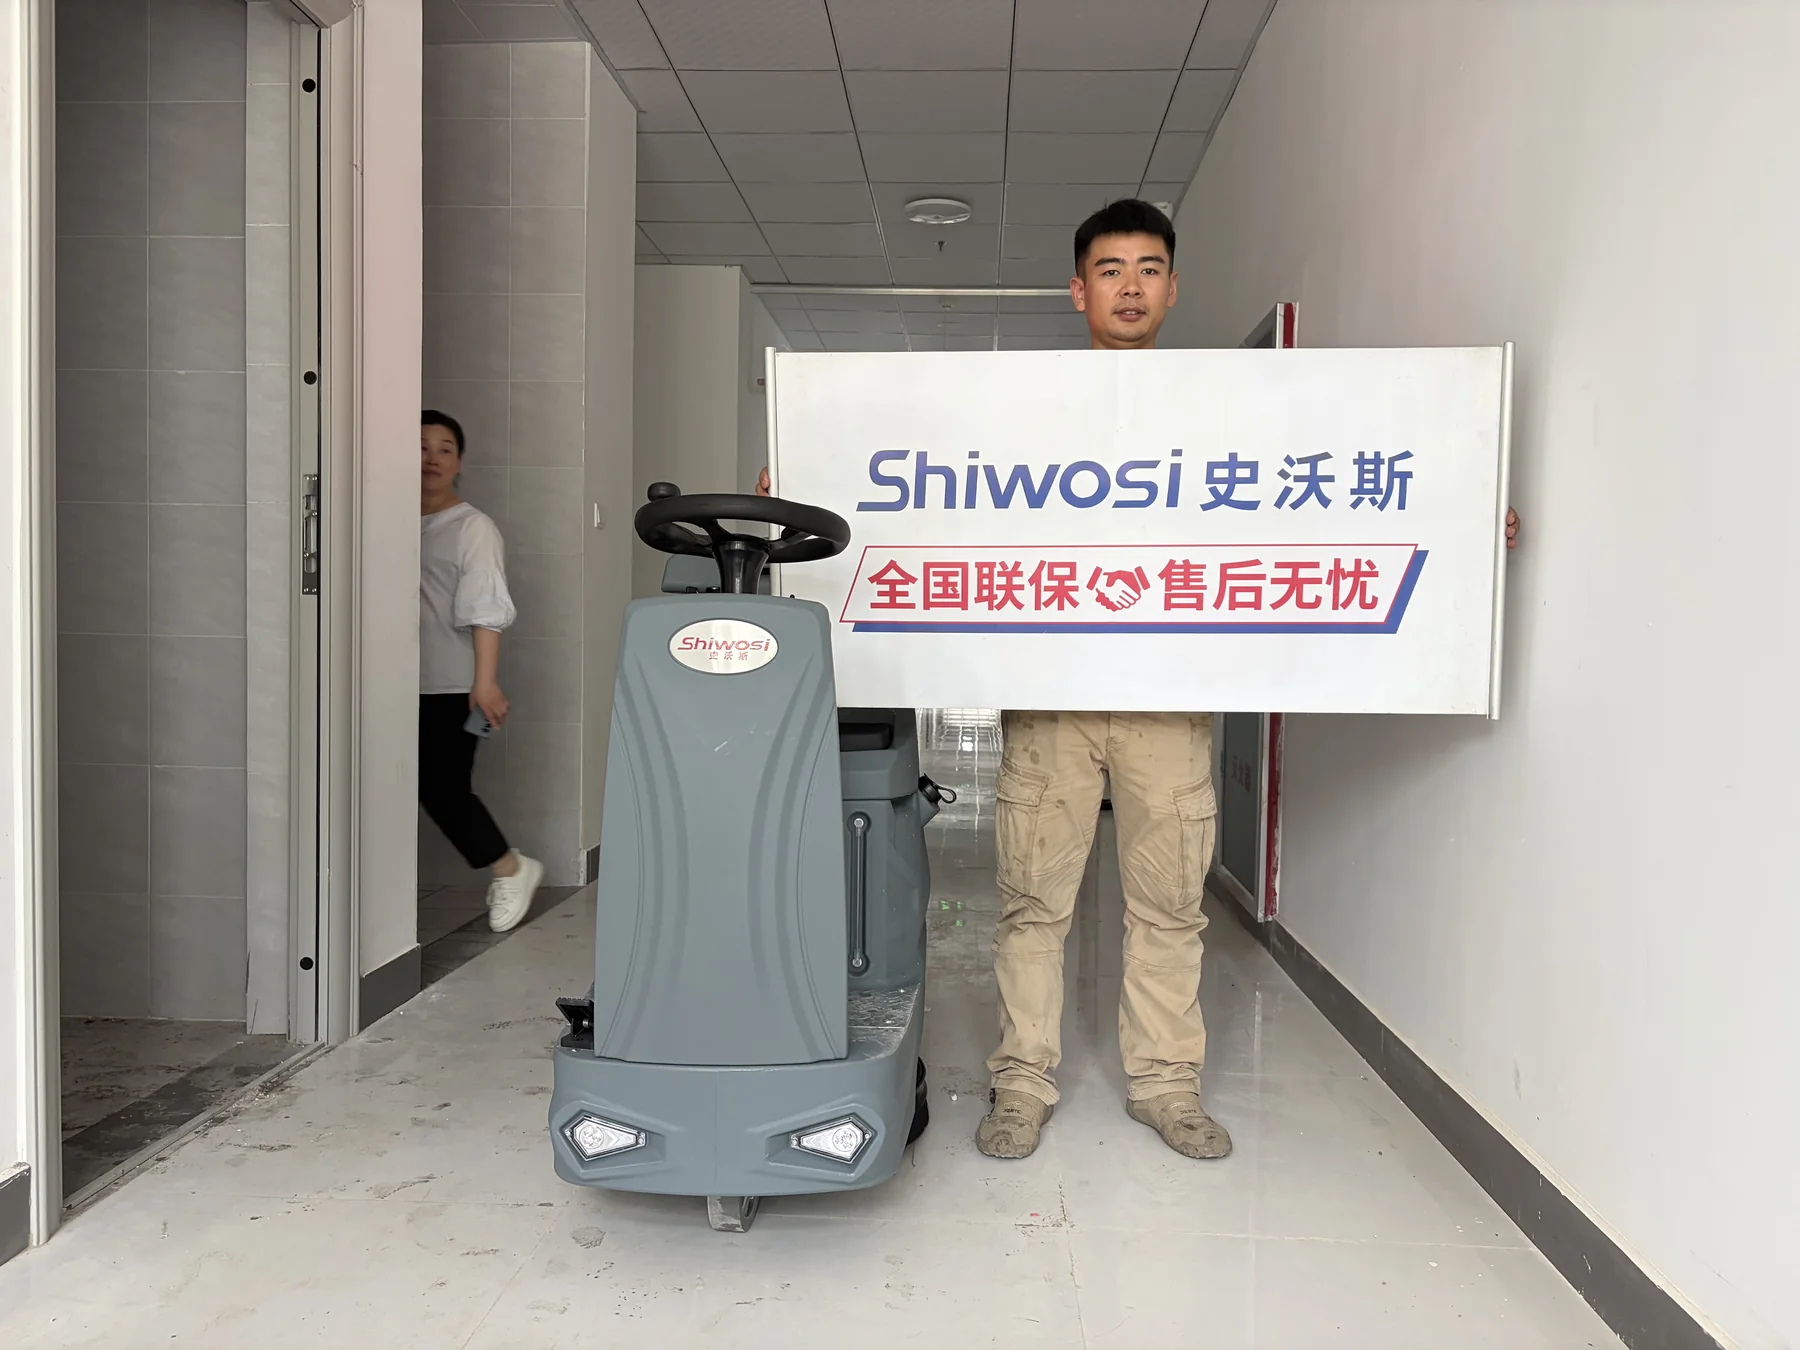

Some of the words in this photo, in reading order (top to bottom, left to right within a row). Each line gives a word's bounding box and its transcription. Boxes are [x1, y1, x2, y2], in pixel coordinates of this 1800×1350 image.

[857, 449, 1183, 511] Shiwosi
[1200, 450, 1414, 511] 史沃斯
[867, 558, 1080, 612] 全国联保
[1157, 557, 1380, 612] 售后无忧
[677, 636, 771, 652] Shiwosi
